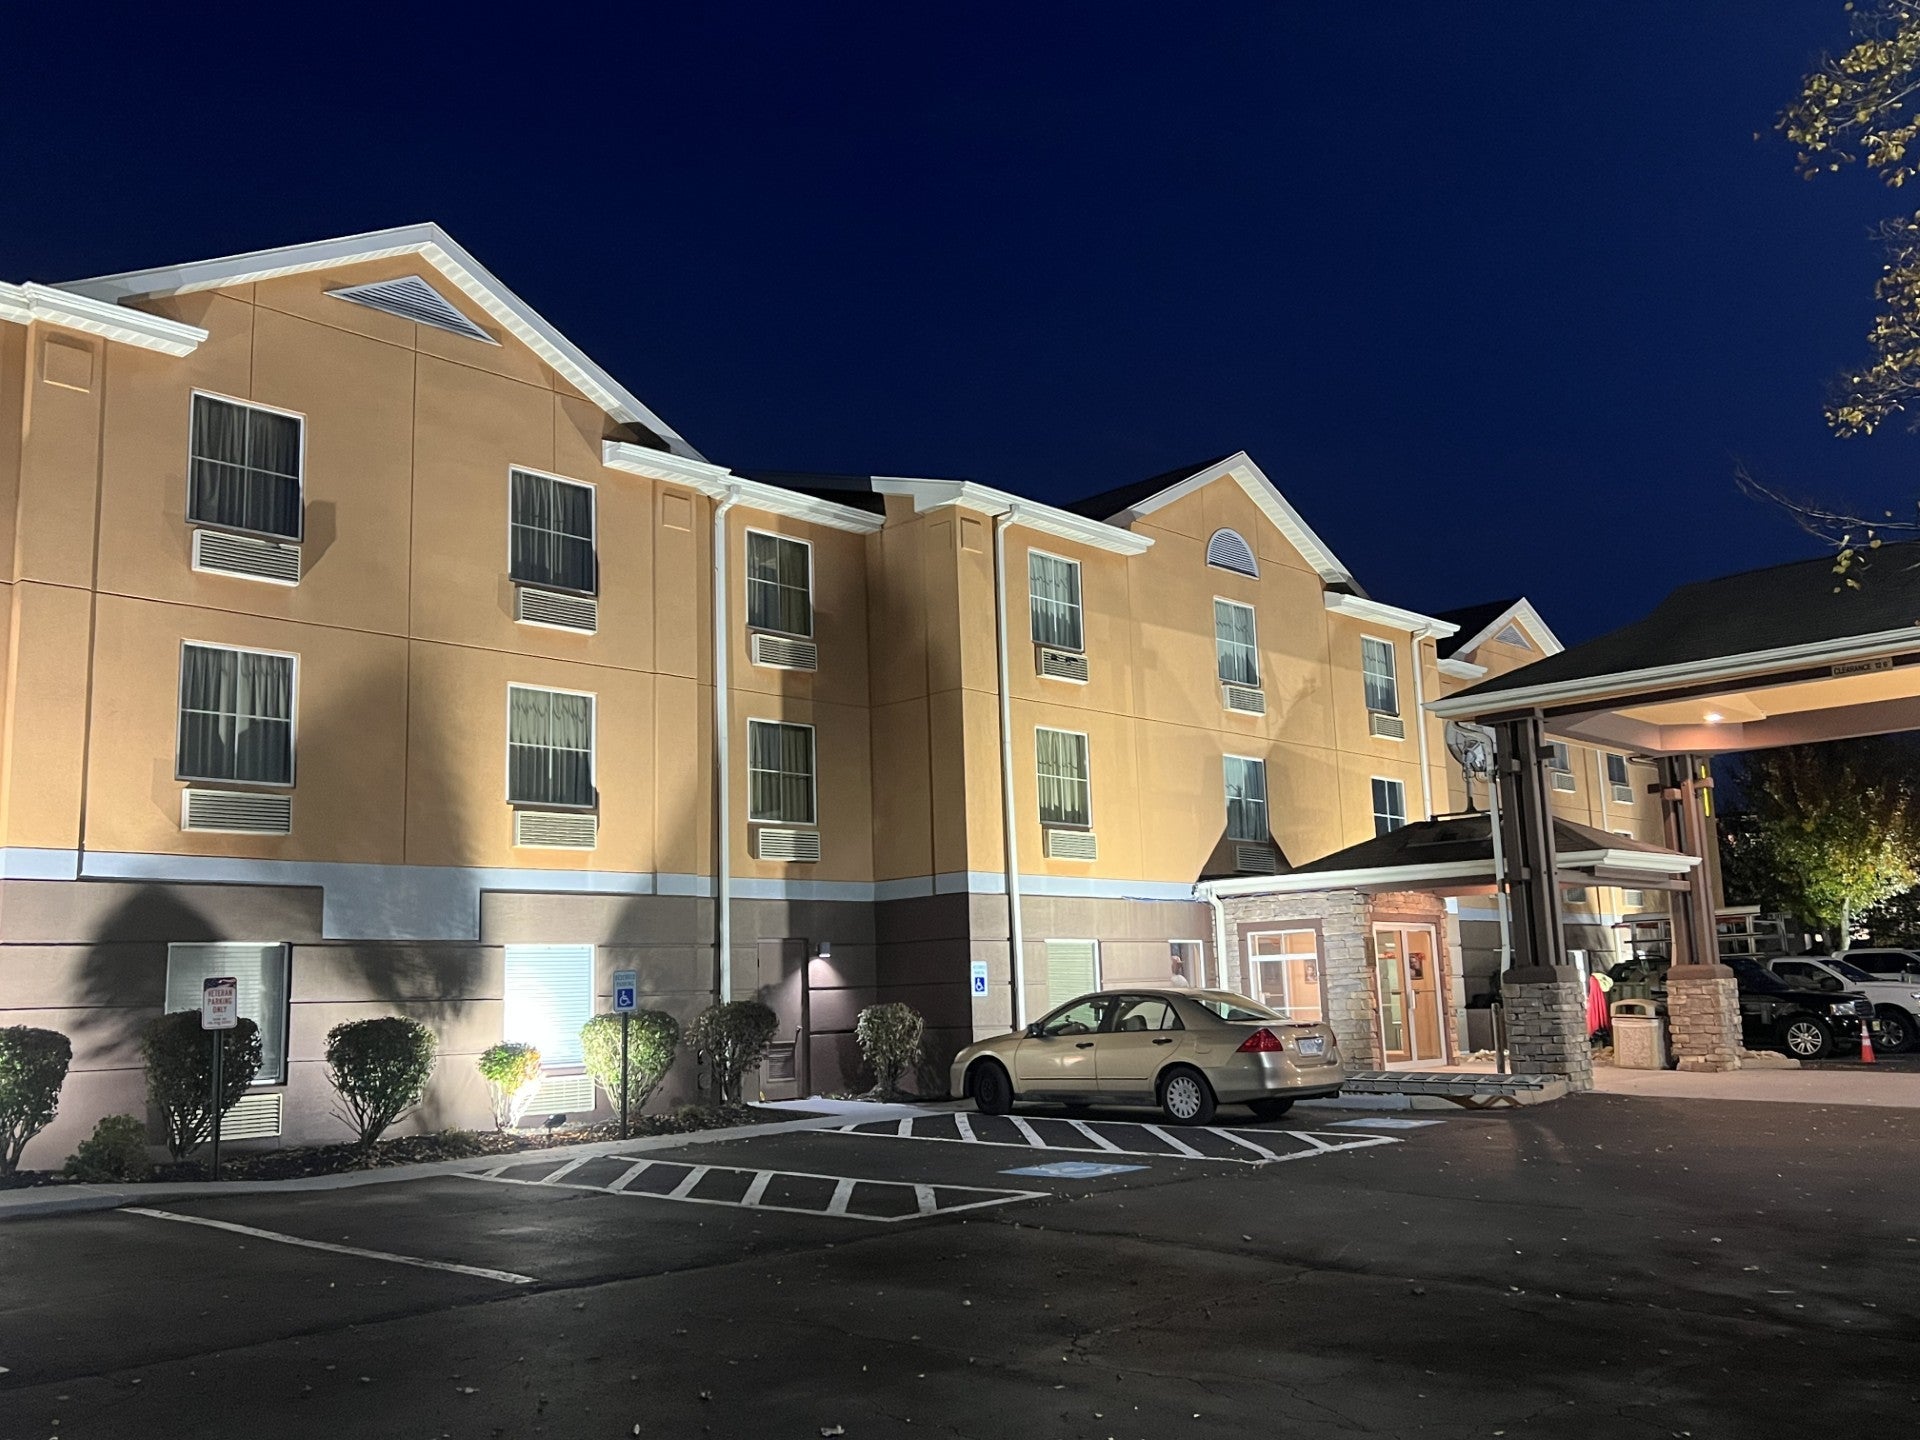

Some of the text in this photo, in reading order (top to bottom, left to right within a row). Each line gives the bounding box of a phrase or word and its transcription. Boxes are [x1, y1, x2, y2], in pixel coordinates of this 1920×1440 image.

[1833, 663, 1872, 675] CLEARANCE
[208, 989, 233, 997] VETERAN
[208, 997, 232, 1006] PARKING
